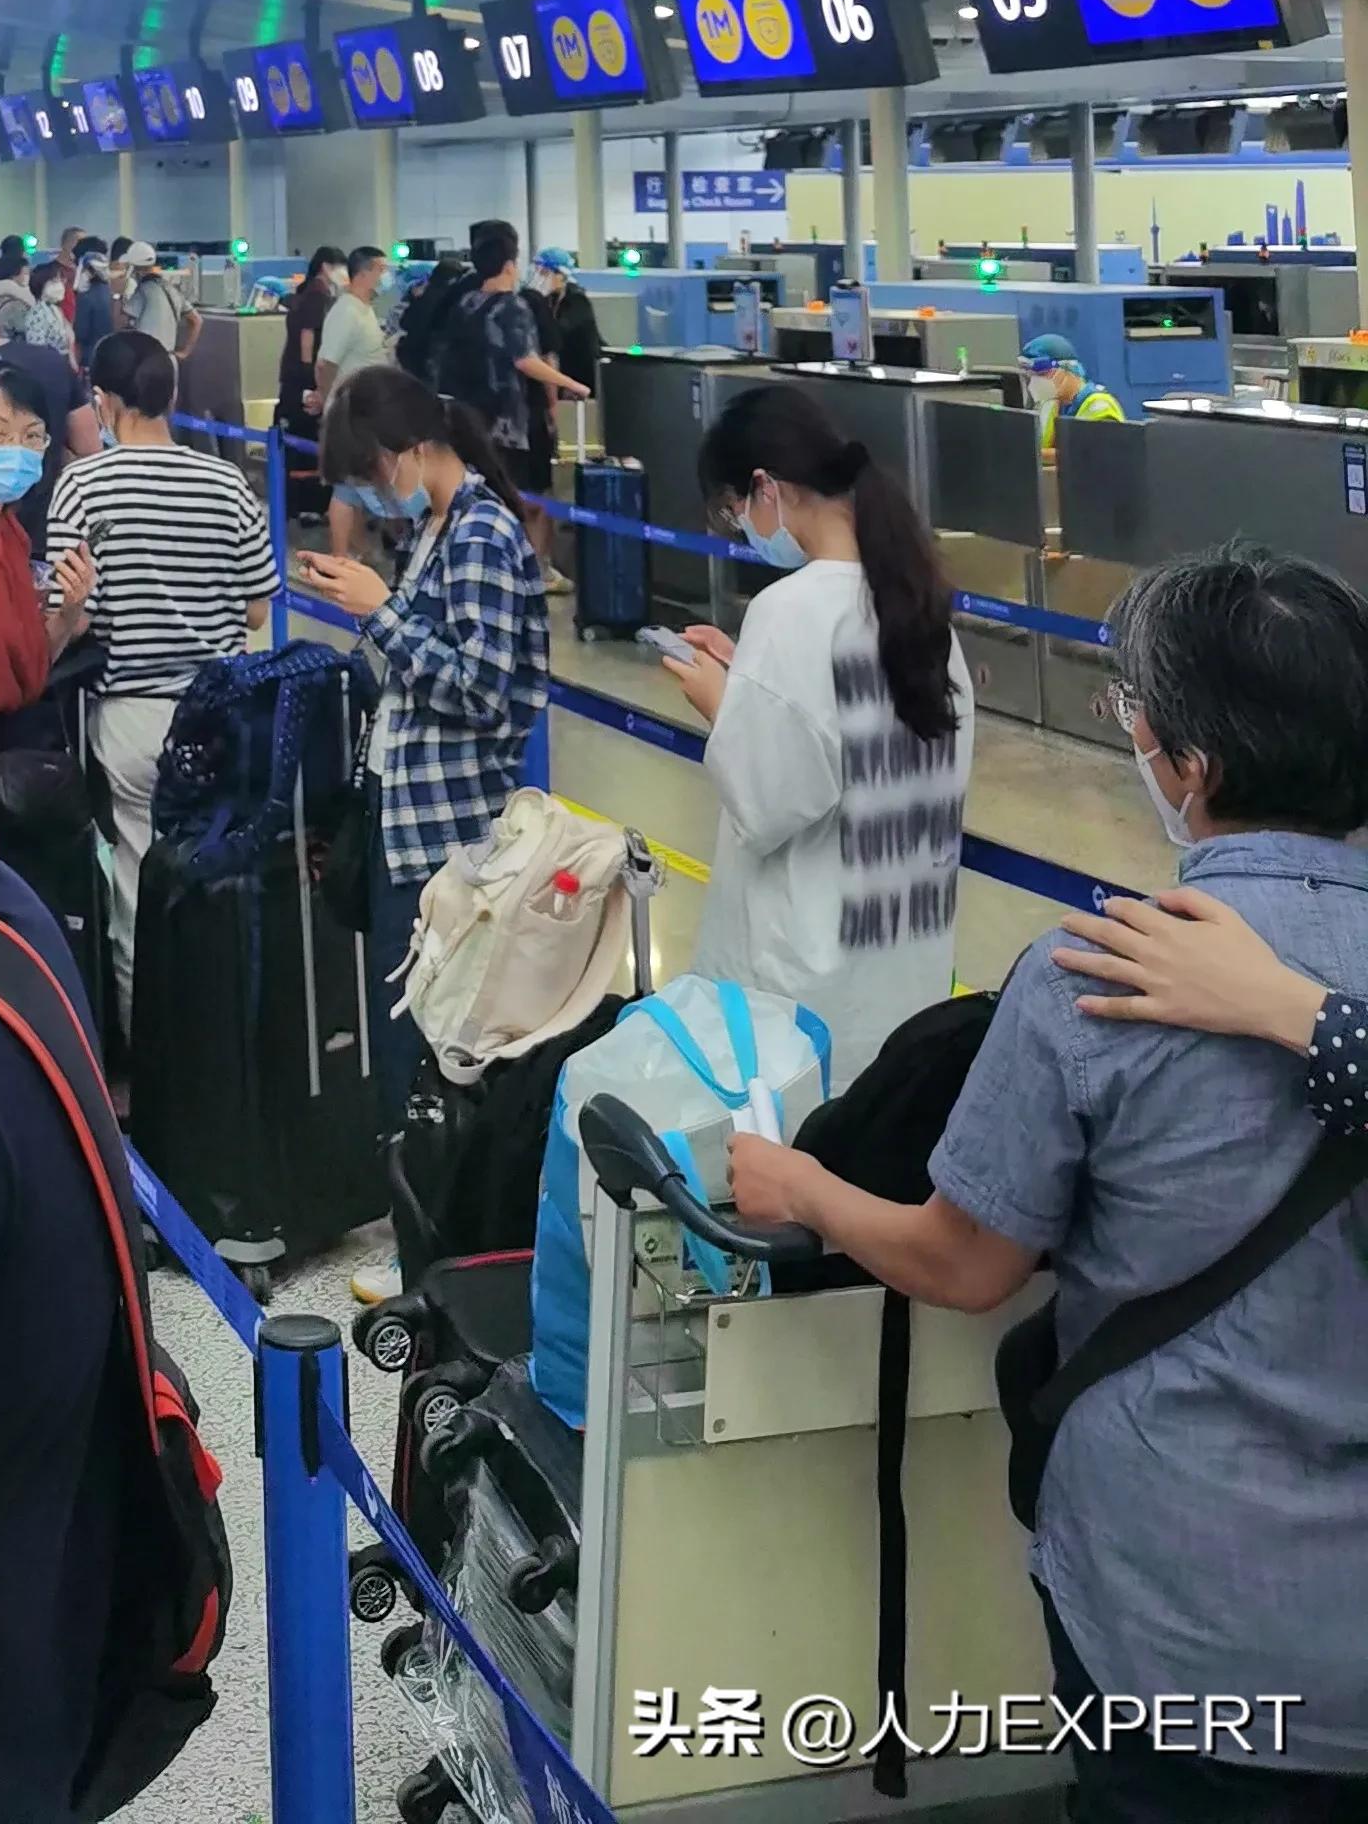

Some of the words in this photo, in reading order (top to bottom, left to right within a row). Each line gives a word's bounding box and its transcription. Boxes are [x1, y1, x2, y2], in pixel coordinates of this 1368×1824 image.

[412, 50, 443, 92] 08
[498, 35, 531, 79] 07
[185, 86, 206, 119] 10
[235, 77, 259, 112] 09
